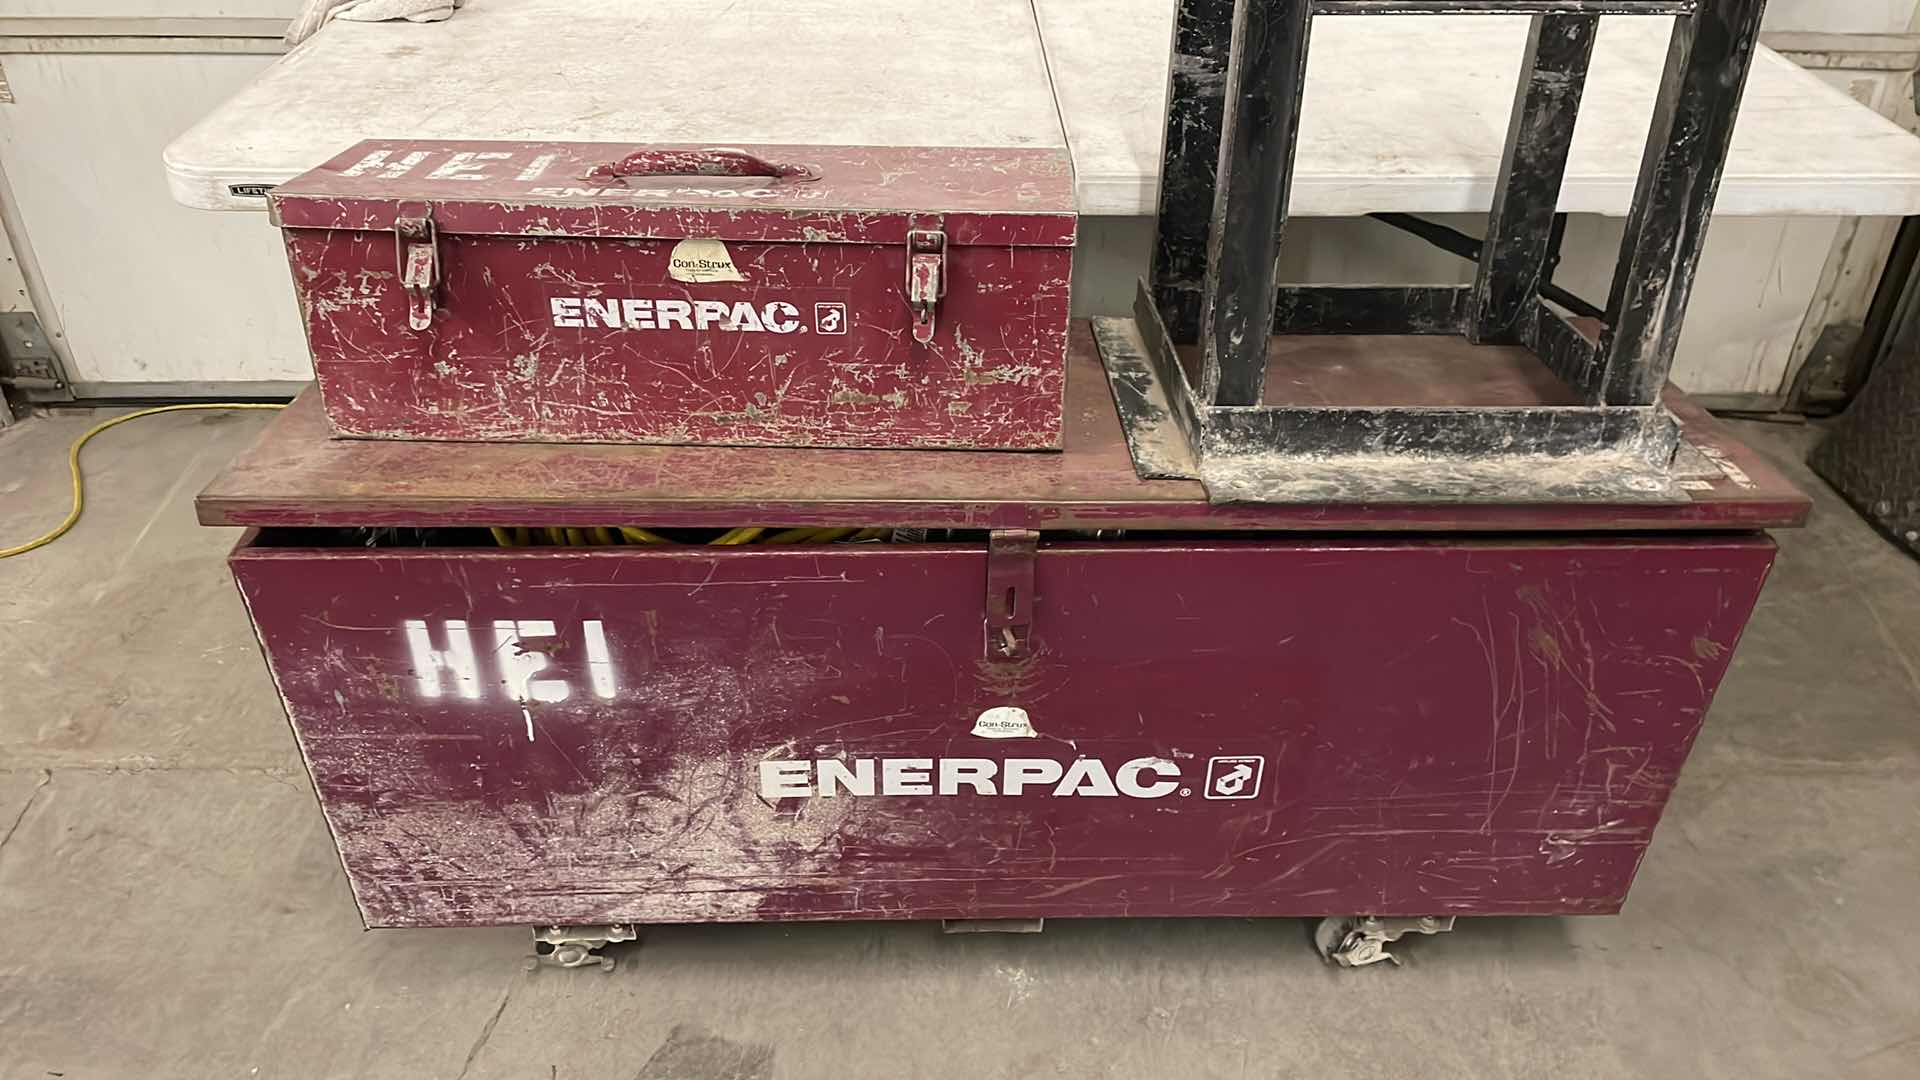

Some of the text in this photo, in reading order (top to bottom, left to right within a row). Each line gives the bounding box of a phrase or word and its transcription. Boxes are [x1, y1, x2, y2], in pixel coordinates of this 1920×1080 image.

[338, 150, 558, 181] HEI
[550, 296, 801, 335] ENERPAC
[404, 620, 616, 703] HEI
[759, 757, 1182, 799] ENERPAC
